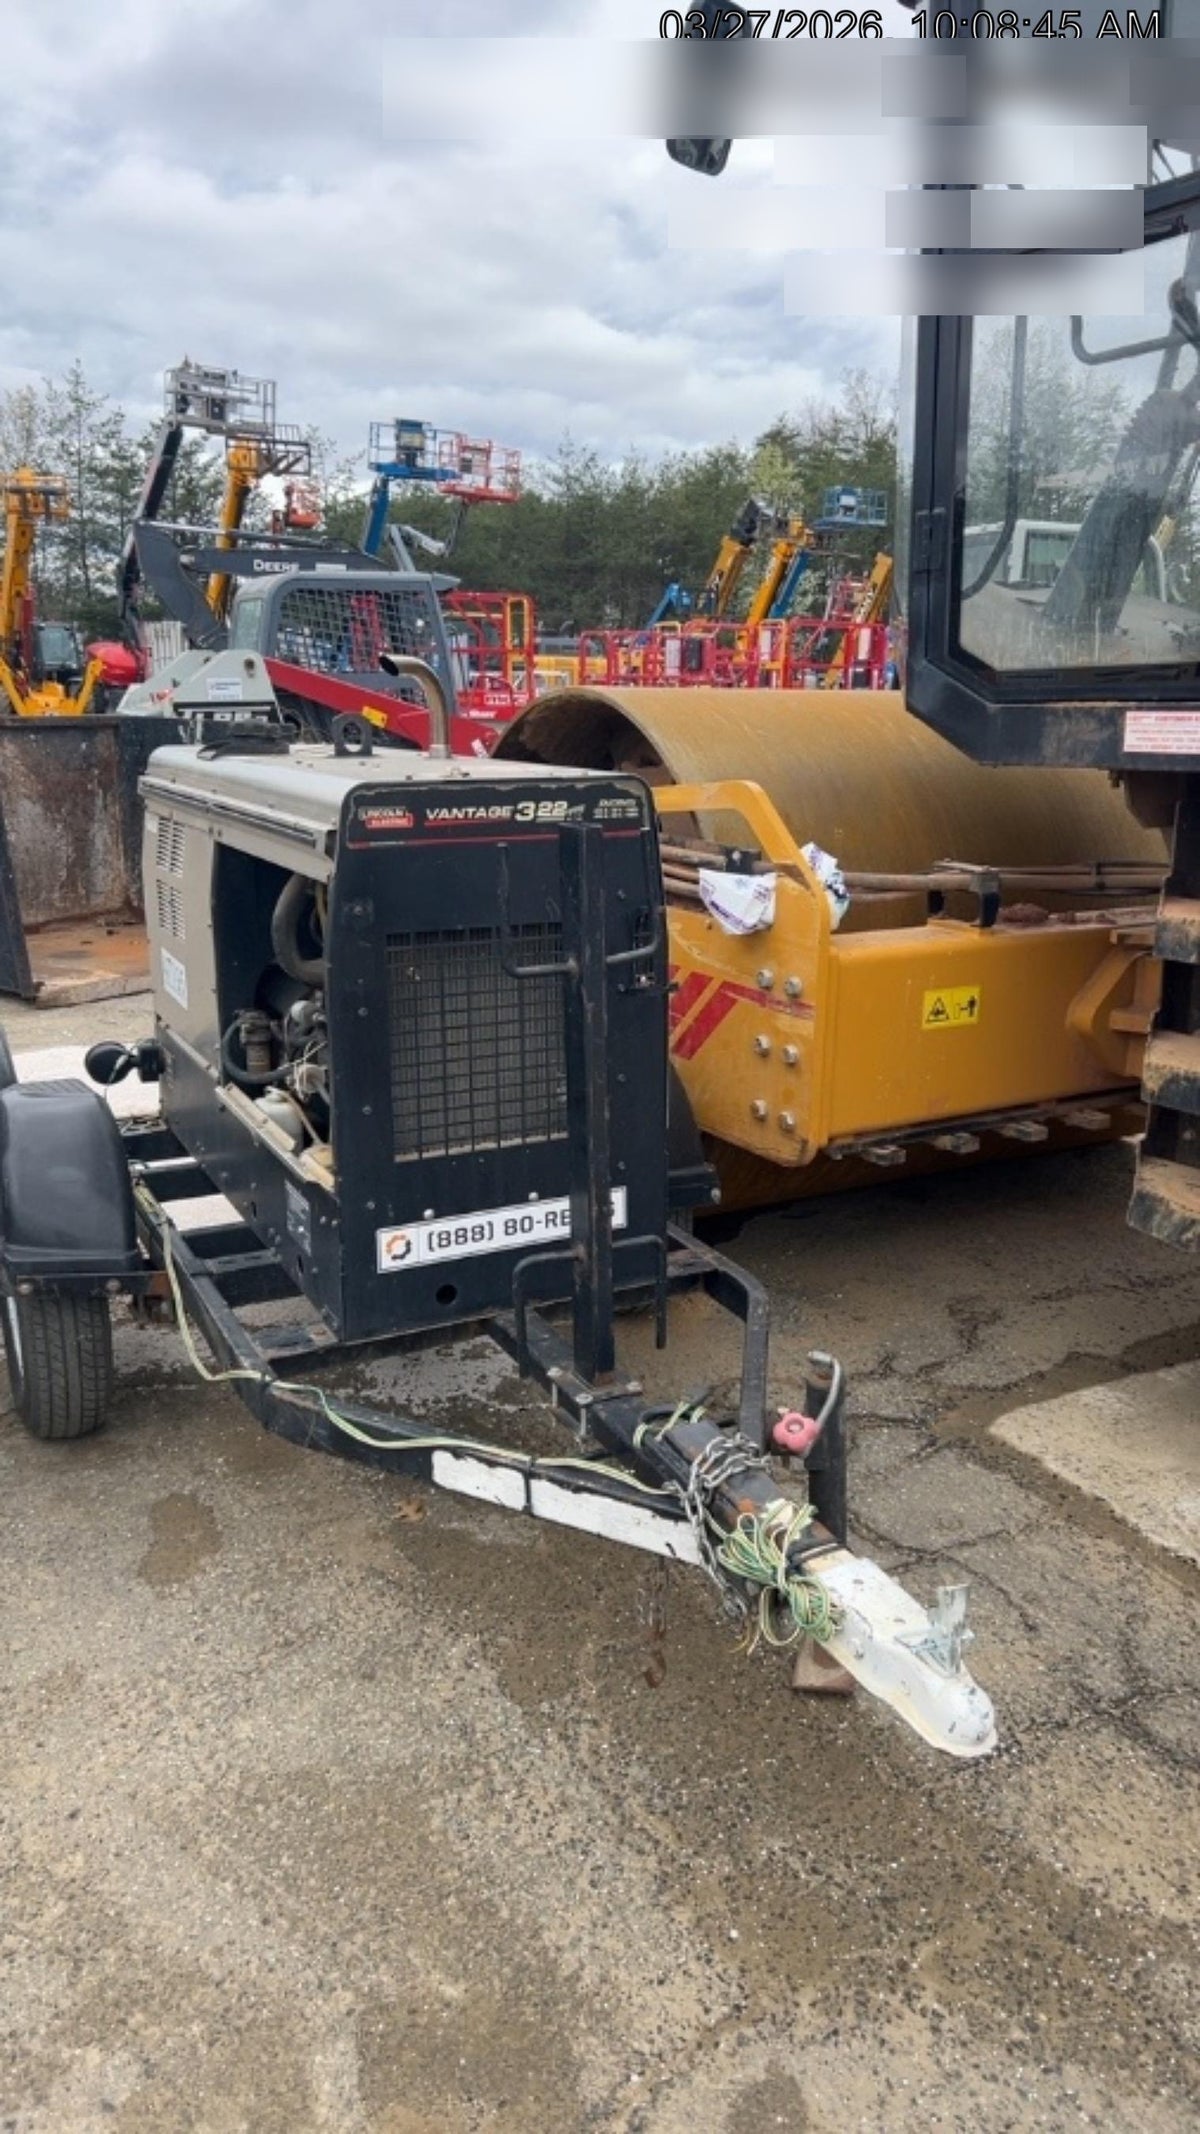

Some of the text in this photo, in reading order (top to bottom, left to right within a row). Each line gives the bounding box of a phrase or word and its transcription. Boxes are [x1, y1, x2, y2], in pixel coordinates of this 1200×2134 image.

[253, 559, 299, 573] DEERE
[425, 805, 513, 820] VANTAGE
[427, 1208, 573, 1252] (888) 80-RE
